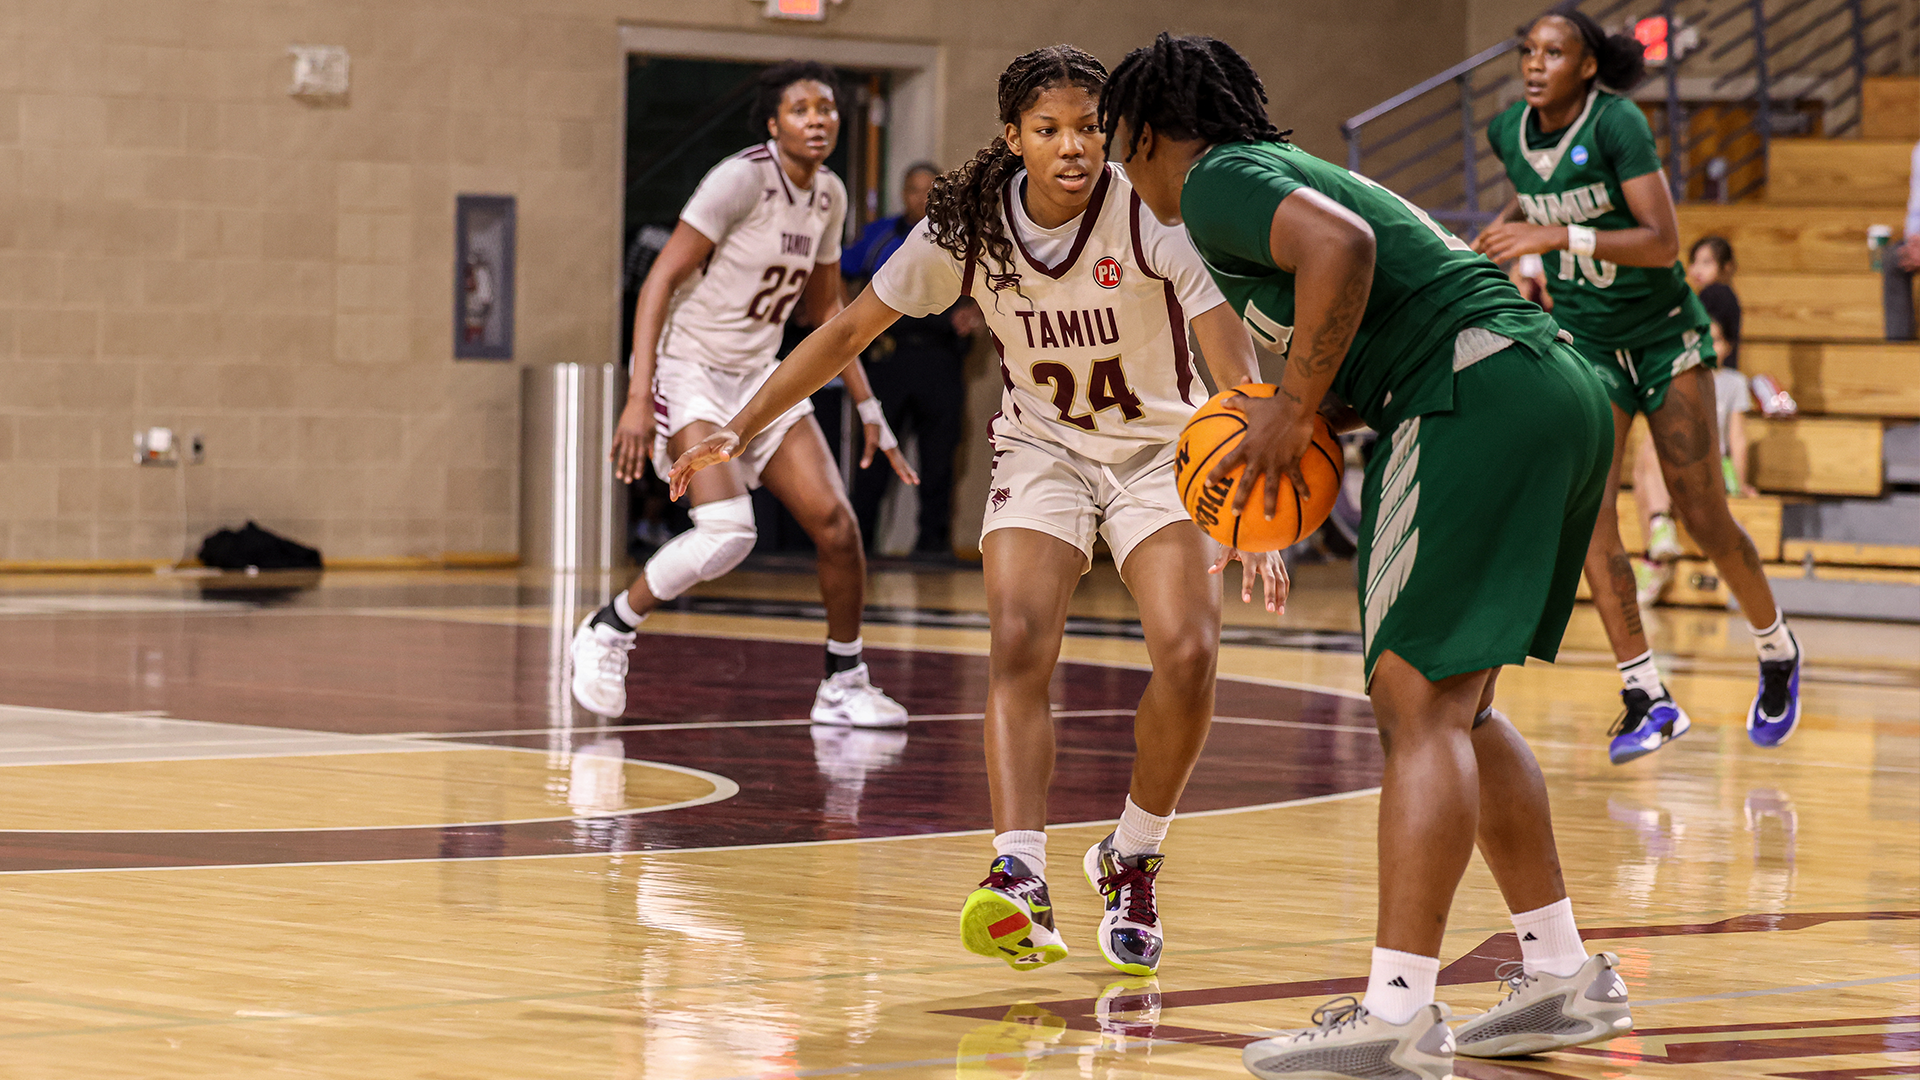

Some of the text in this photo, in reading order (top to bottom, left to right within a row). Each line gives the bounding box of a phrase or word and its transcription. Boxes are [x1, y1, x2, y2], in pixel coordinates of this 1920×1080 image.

[747, 265, 808, 325] 22
[1097, 263, 1119, 282] PA
[1014, 306, 1120, 349] TAMIU
[1030, 353, 1147, 432] 24
